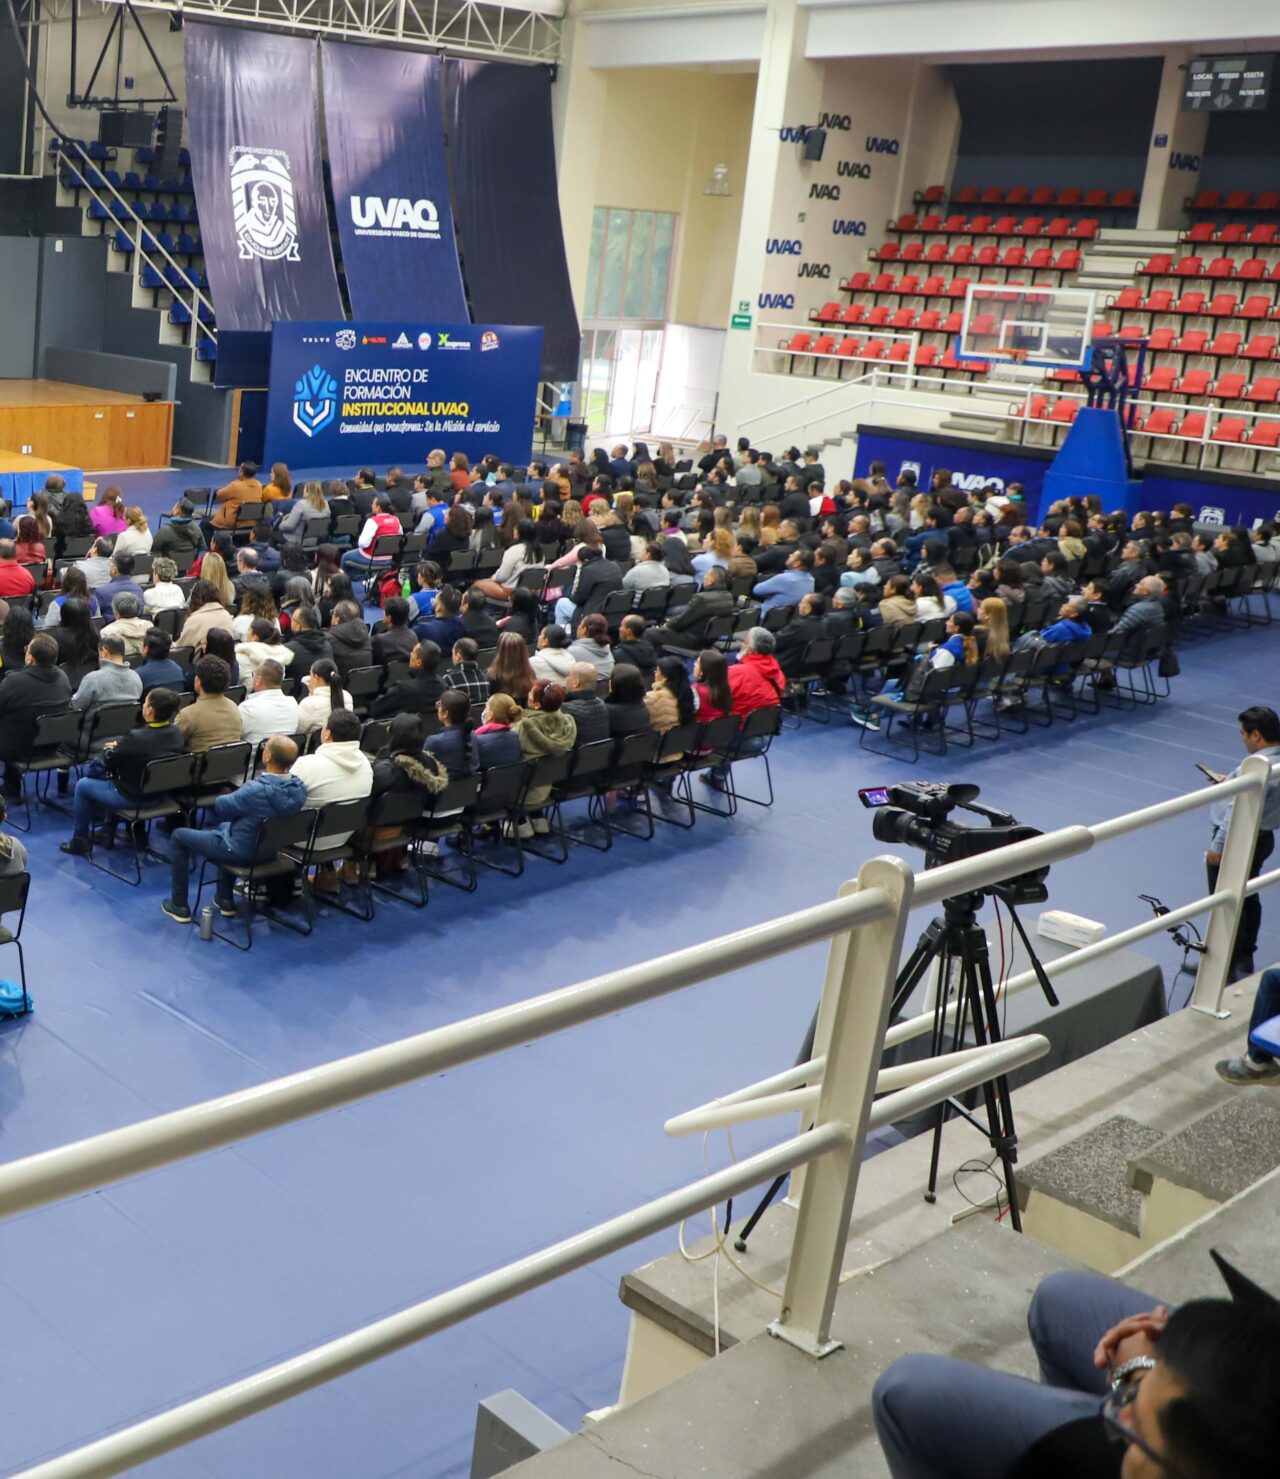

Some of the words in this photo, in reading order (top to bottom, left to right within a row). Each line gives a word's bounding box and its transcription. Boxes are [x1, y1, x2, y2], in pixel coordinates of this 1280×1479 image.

[865, 136, 900, 155] UVAQ
[837, 161, 872, 179] UVAQ
[350, 195, 440, 231] UVAQ
[832, 219, 867, 236] UVAQ
[765, 239, 802, 255] UVAQ
[758, 293, 795, 309] UVAQ
[344, 368, 411, 383] ENCUENTRO
[412, 368, 429, 383] DE
[343, 382, 412, 400] FORMACIÓN
[341, 402, 430, 417] INSTITUCIONAL
[431, 402, 470, 417] UVAQ
[340, 420, 374, 434] Comunidad
[374, 422, 385, 435] que
[385, 420, 424, 434] transforma:
[424, 420, 434, 433] De
[435, 420, 442, 432] la
[442, 420, 466, 433] Misión
[466, 420, 475, 432] al
[474, 420, 500, 433] servicio
